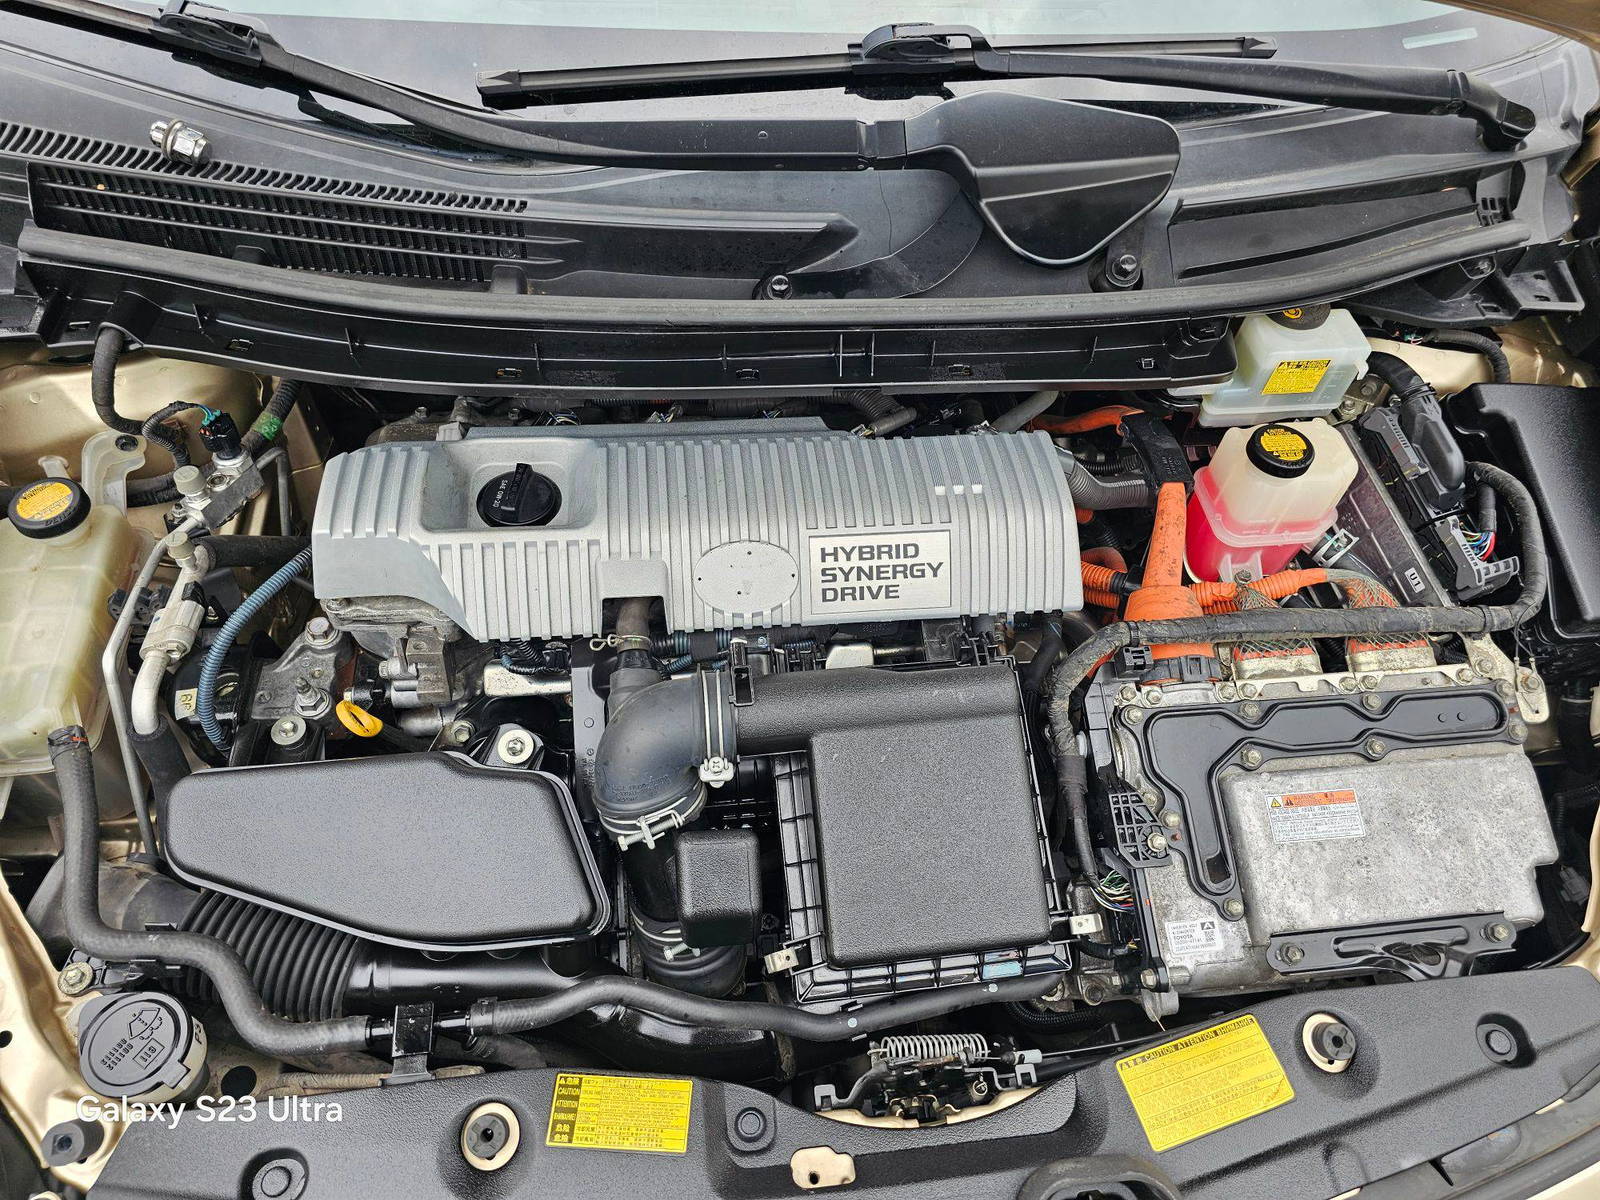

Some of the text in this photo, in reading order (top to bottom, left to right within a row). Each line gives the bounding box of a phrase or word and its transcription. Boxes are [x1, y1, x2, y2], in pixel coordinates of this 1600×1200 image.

[500, 479, 508, 489] SAE
[820, 543, 919, 563] HYBRID
[820, 562, 944, 583] SYNERGY
[1409, 572, 1421, 586] U1
[821, 584, 900, 603] DRIVE
[1145, 1032, 1215, 1061] CAUTION ATTENTION
[558, 1087, 581, 1096] CAUTION
